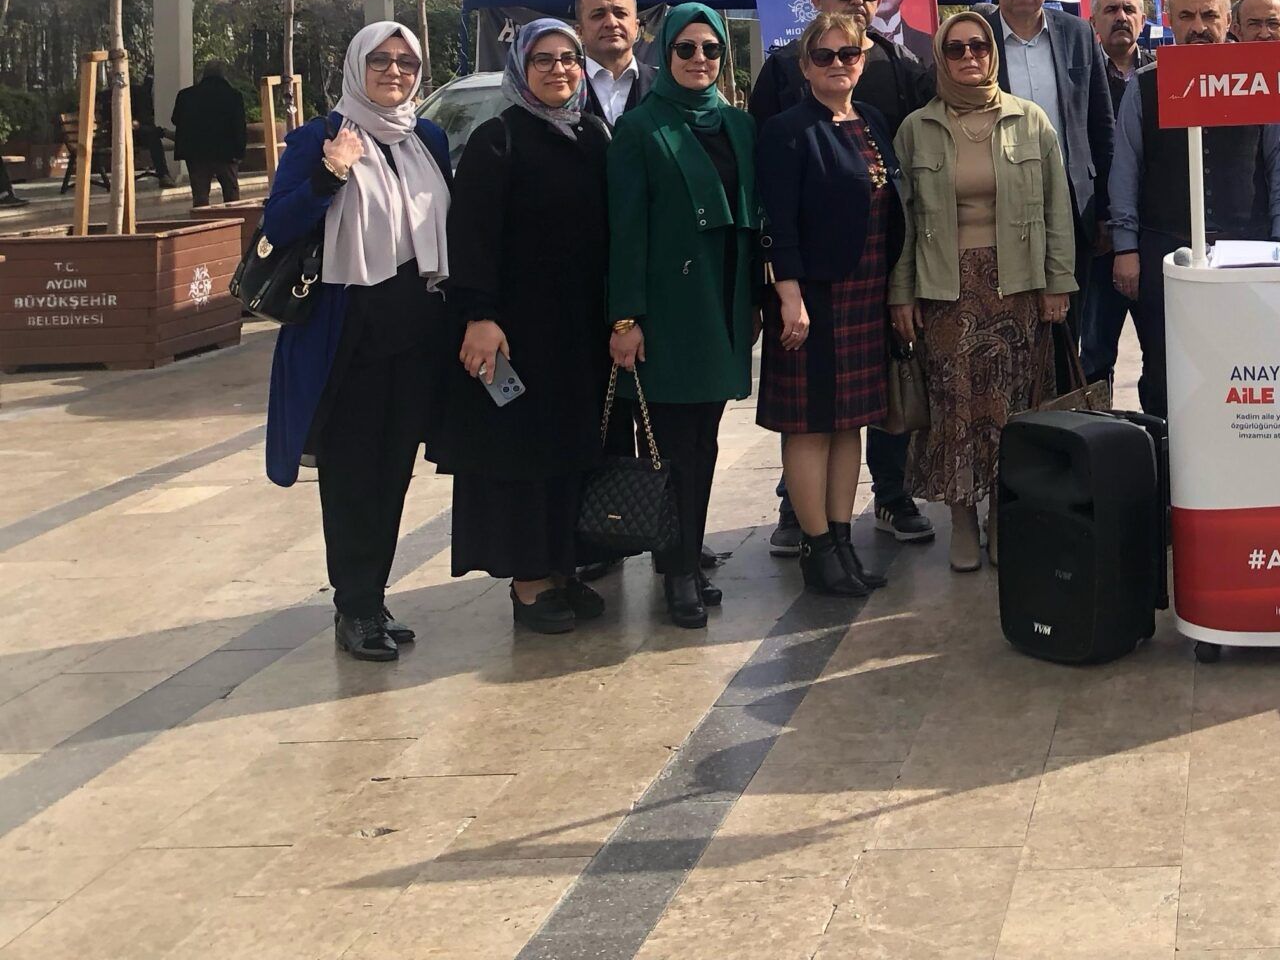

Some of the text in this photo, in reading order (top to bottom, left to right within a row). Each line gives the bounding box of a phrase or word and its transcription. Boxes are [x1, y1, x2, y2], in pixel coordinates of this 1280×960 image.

[54, 262, 78, 272] T.C.
[46, 279, 87, 290] AYDIN
[14, 294, 117, 310] BÜYÜKŞEHİR
[27, 313, 104, 327] BELEDİYESİ
[1226, 387, 1274, 404] AİLE
[1033, 621, 1052, 635] TVM
